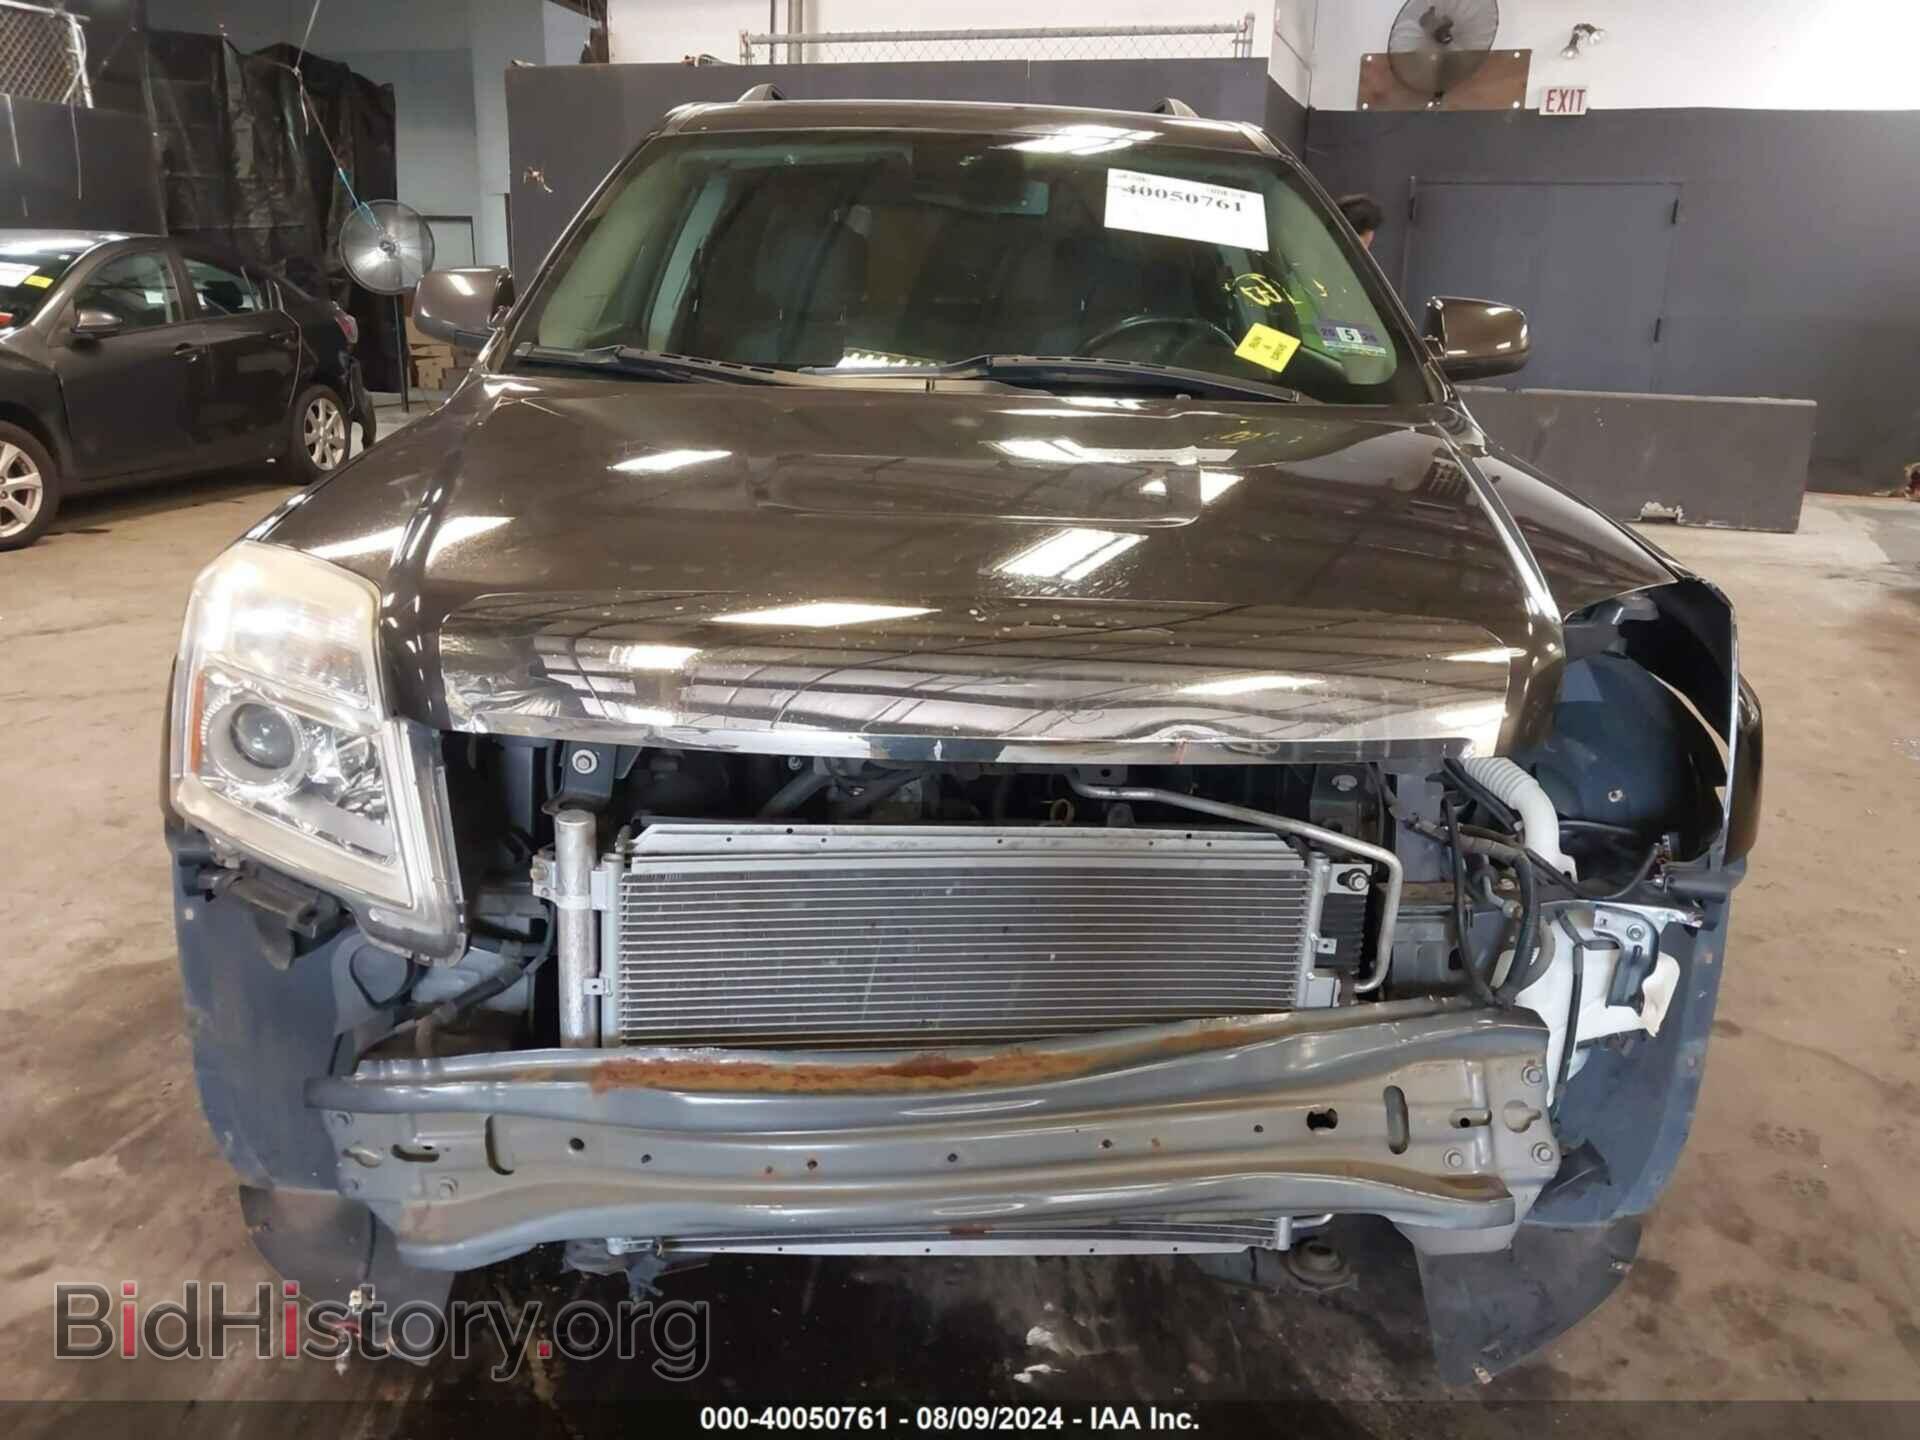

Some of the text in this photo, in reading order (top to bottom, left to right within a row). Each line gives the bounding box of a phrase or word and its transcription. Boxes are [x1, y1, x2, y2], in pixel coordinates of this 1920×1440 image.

[1545, 88, 1587, 113] EXIT
[1120, 183, 1242, 213] 40050761
[1344, 328, 1356, 341] 5
